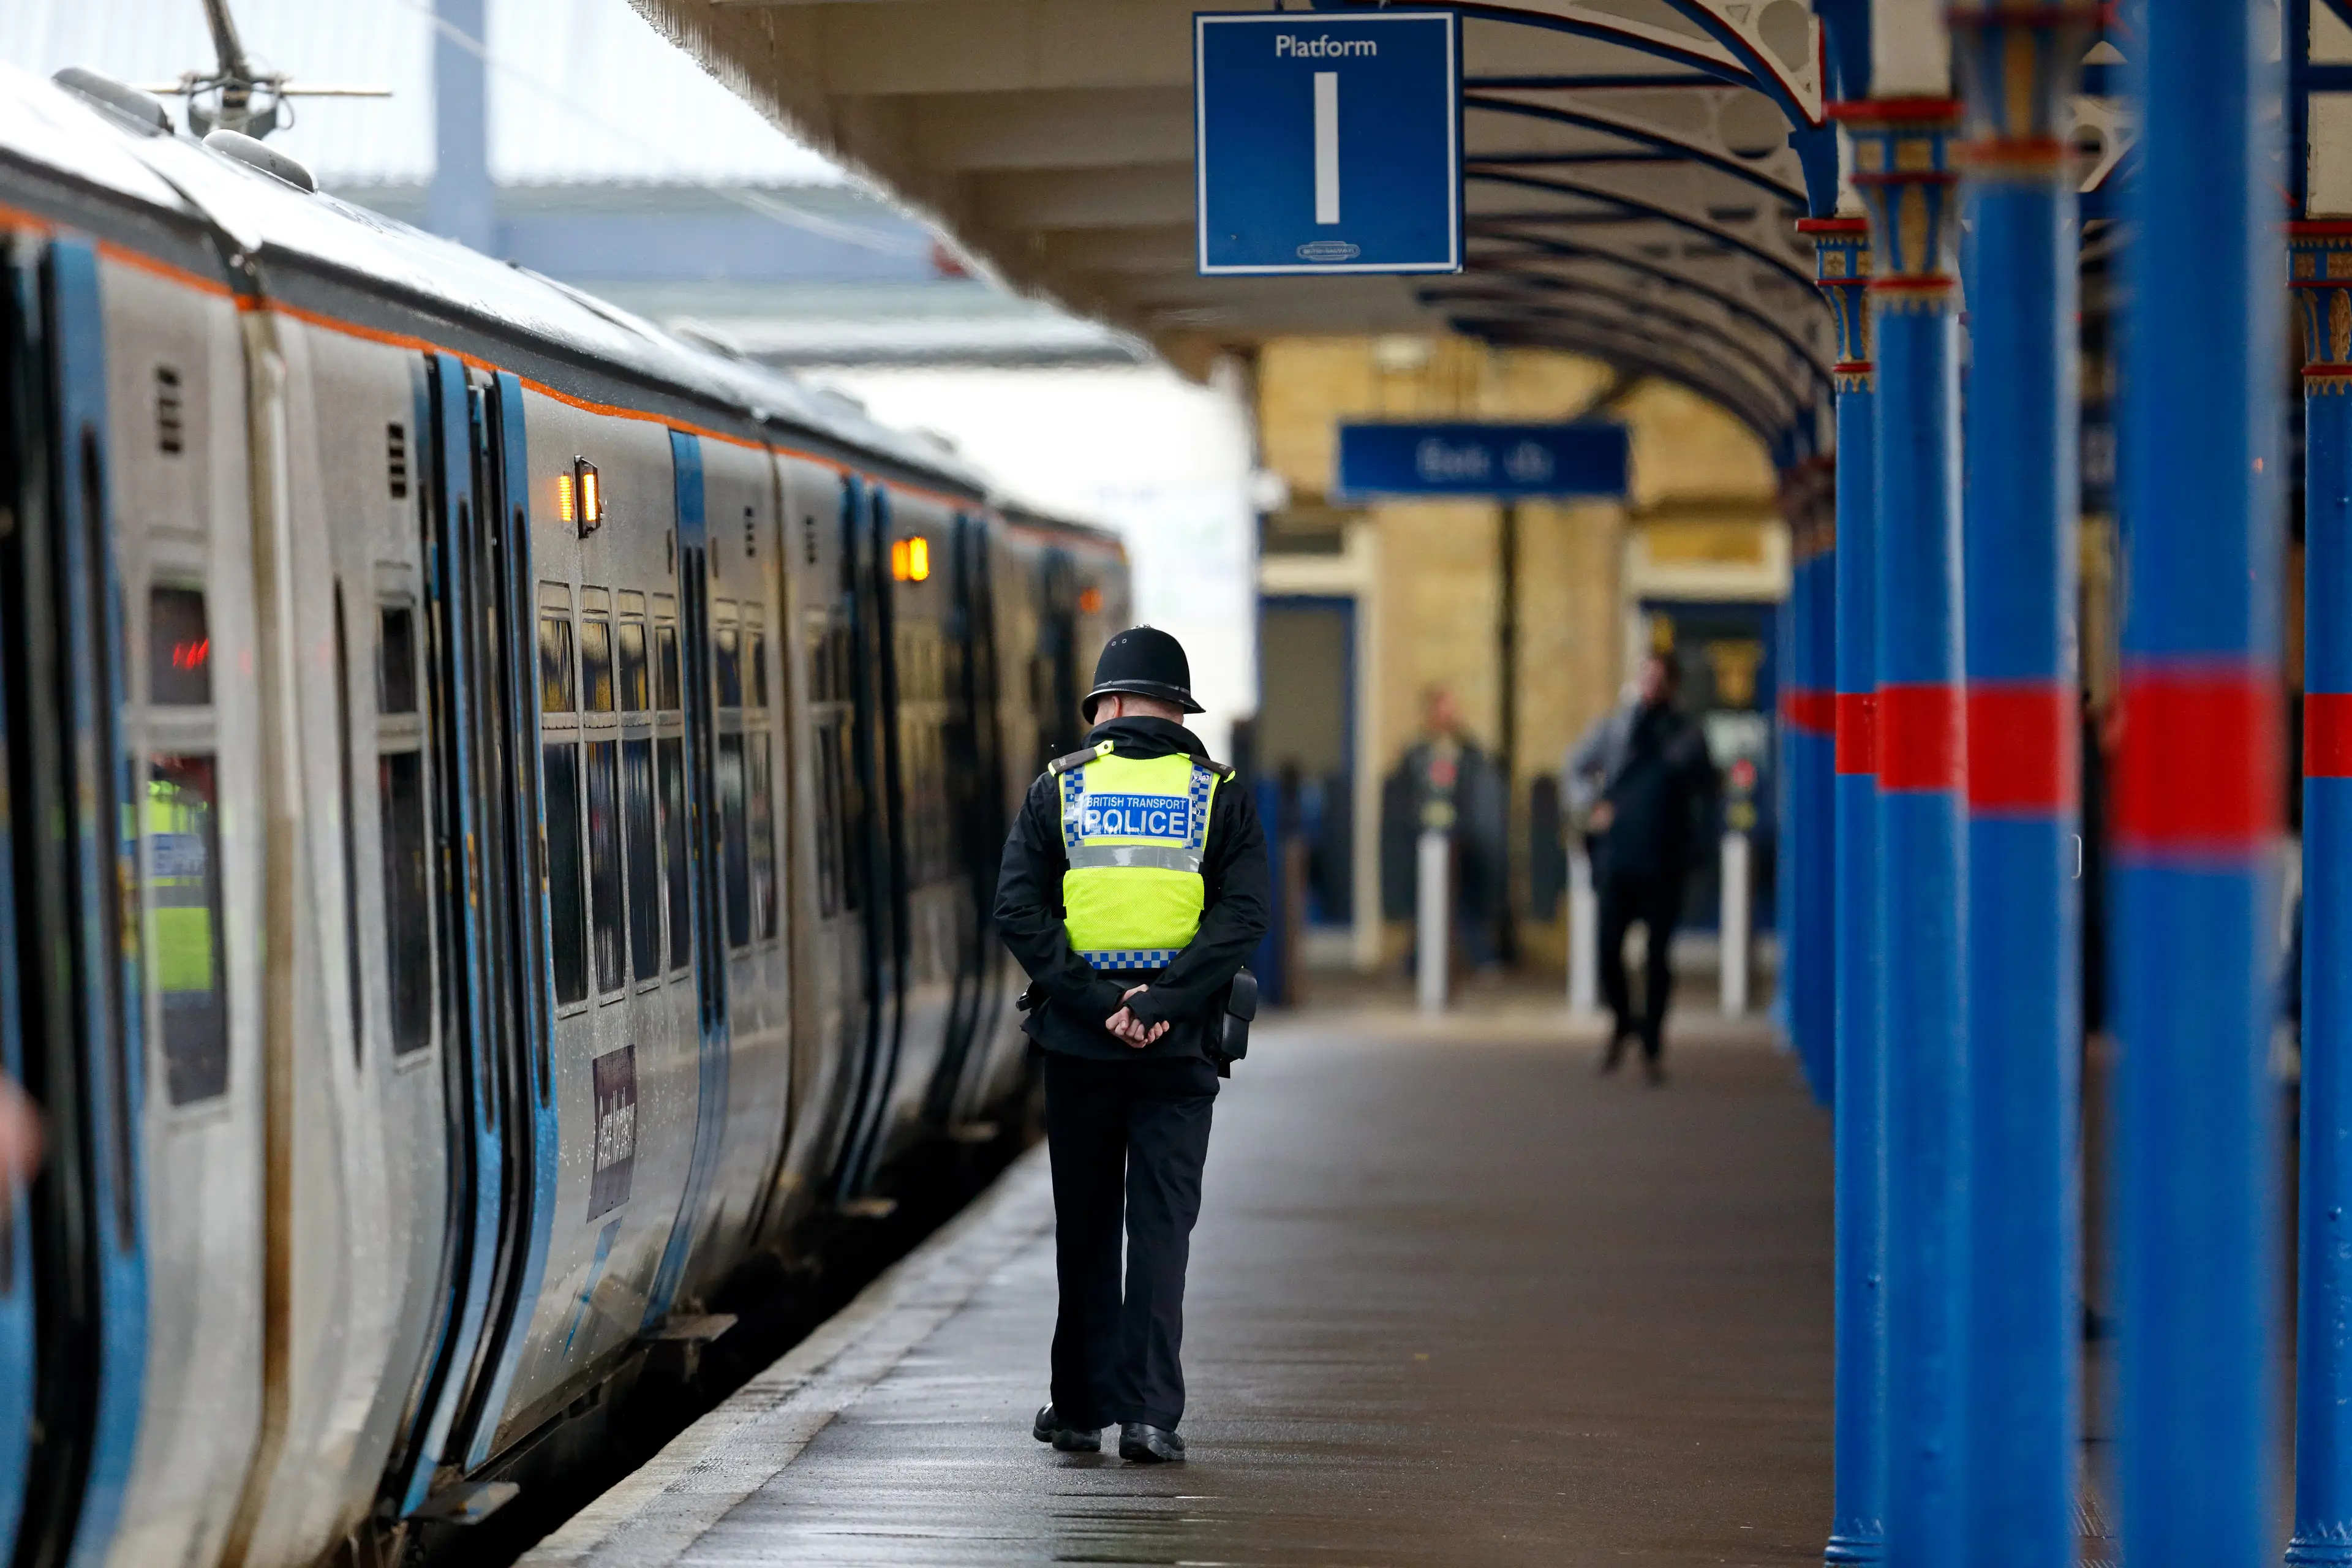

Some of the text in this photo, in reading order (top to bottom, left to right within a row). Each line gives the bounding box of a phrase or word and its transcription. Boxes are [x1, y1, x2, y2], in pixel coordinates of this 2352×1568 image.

[1275, 34, 1378, 58] Platform
[1087, 796, 1186, 810] BRITISH TRANSPORT
[1085, 809, 1186, 835] POLICE
